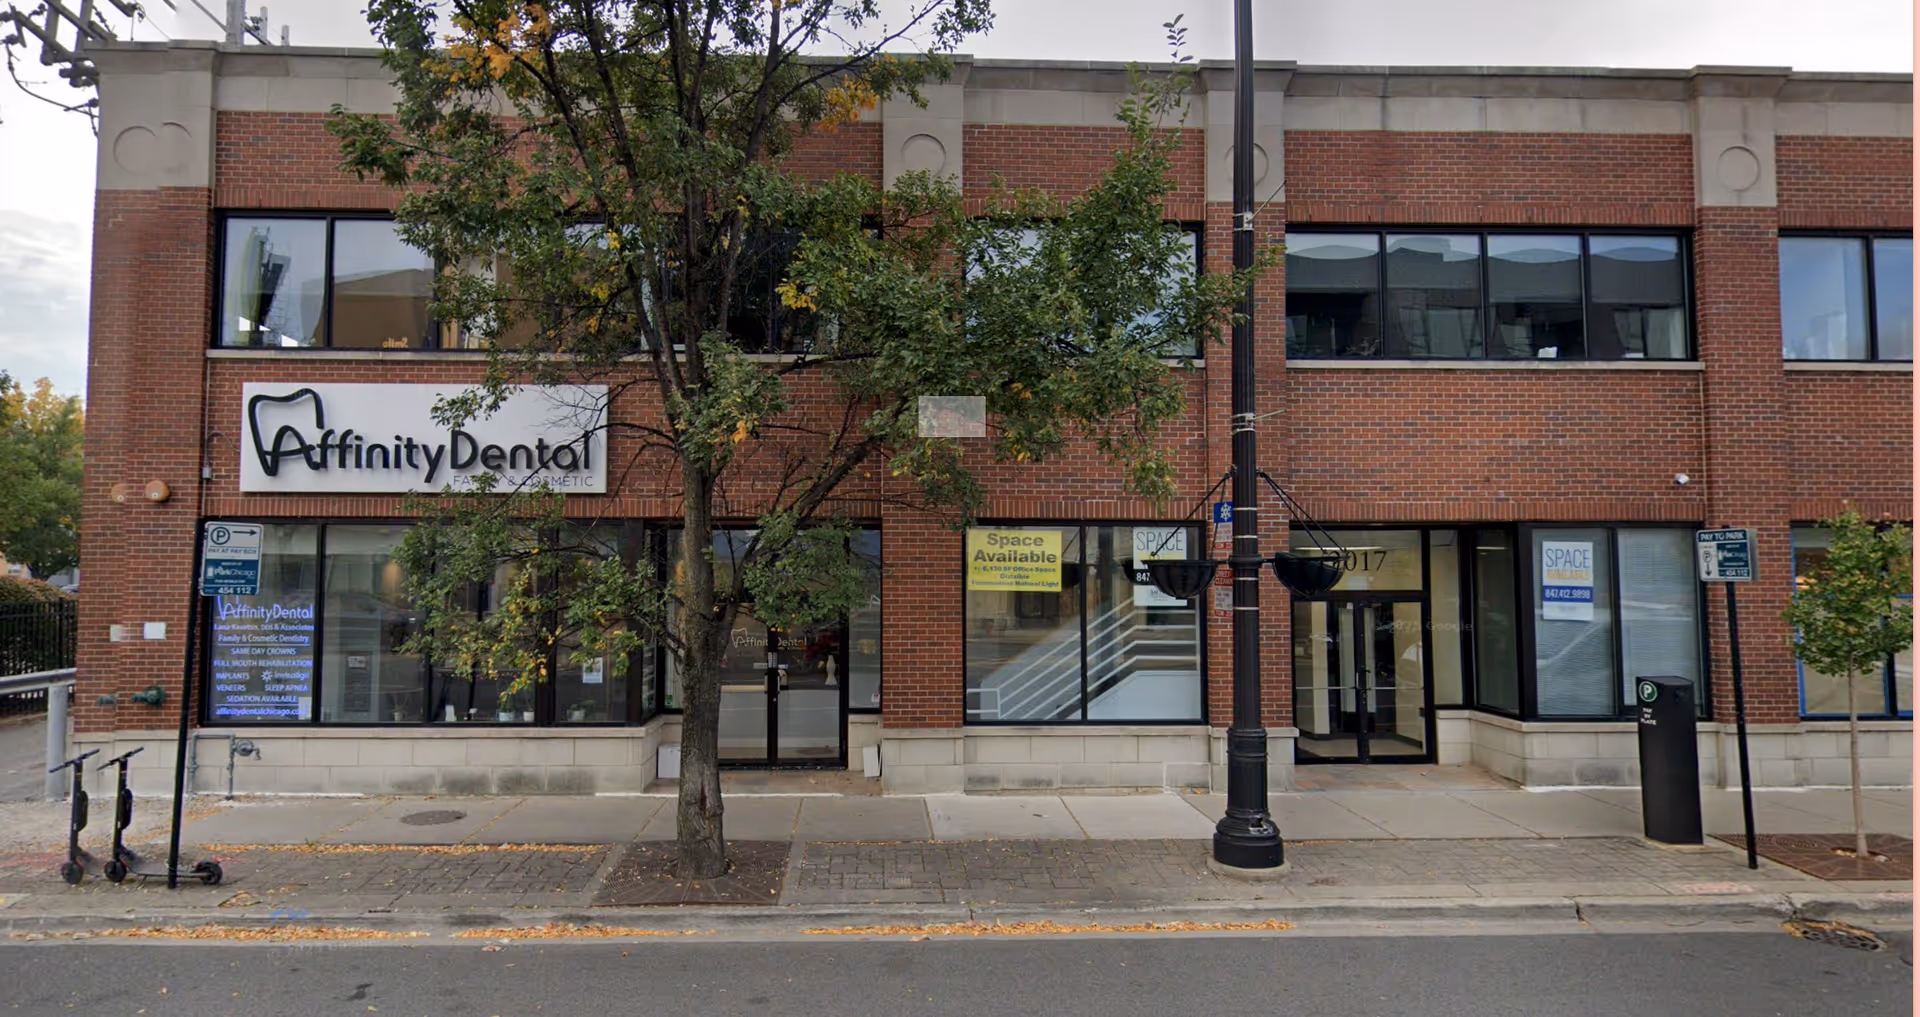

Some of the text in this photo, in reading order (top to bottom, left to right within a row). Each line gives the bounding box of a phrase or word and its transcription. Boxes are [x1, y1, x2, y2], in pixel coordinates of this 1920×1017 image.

[521, 475, 593, 487] COSMETIC
[216, 530, 226, 541] P
[987, 532, 1044, 549] Space
[1136, 531, 1183, 551] SPACE
[1700, 531, 1745, 541] PAY TO PARK
[974, 549, 1057, 563] Available
[1545, 548, 1590, 568] SPACE
[218, 586, 234, 594] 454
[236, 586, 252, 594] 112
[217, 634, 241, 643] Family
[248, 634, 278, 642] Cosmetic
[279, 634, 311, 643] Dentistry
[215, 672, 250, 680] IMPLANTS
[215, 684, 309, 692] VENEERS SLEEP APNEA
[1643, 684, 1653, 698] P
